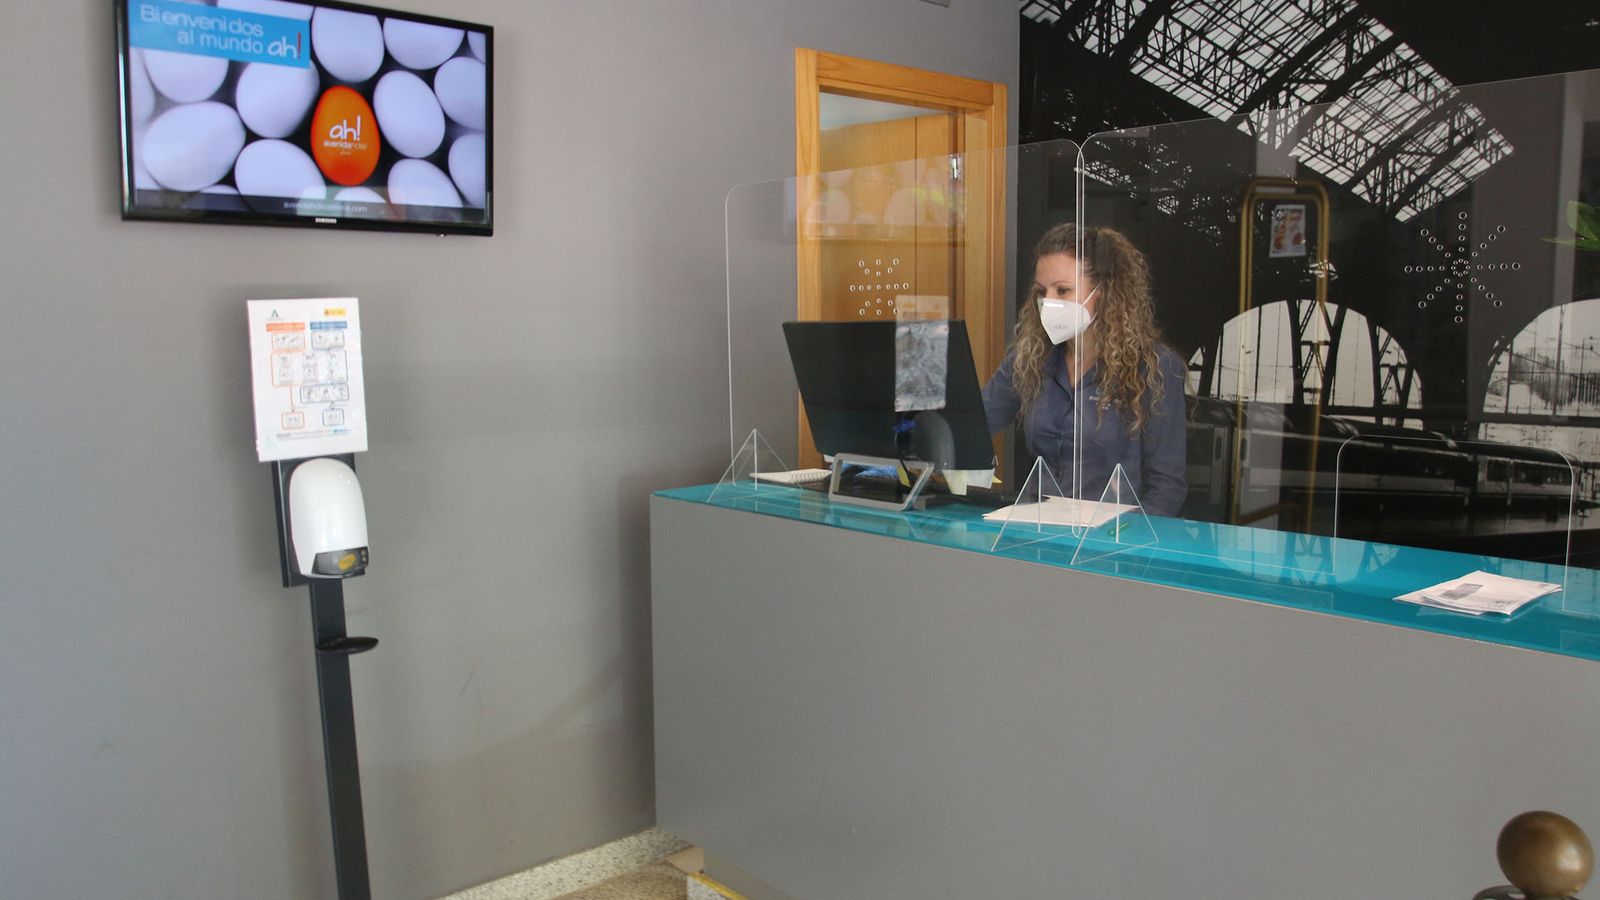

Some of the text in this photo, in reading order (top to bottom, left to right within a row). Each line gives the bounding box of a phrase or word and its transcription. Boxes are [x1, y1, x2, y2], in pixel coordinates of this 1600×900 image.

[140, 4, 264, 37] Bienvenidos
[177, 30, 301, 59] al mundo ah!
[329, 115, 361, 141] ah!
